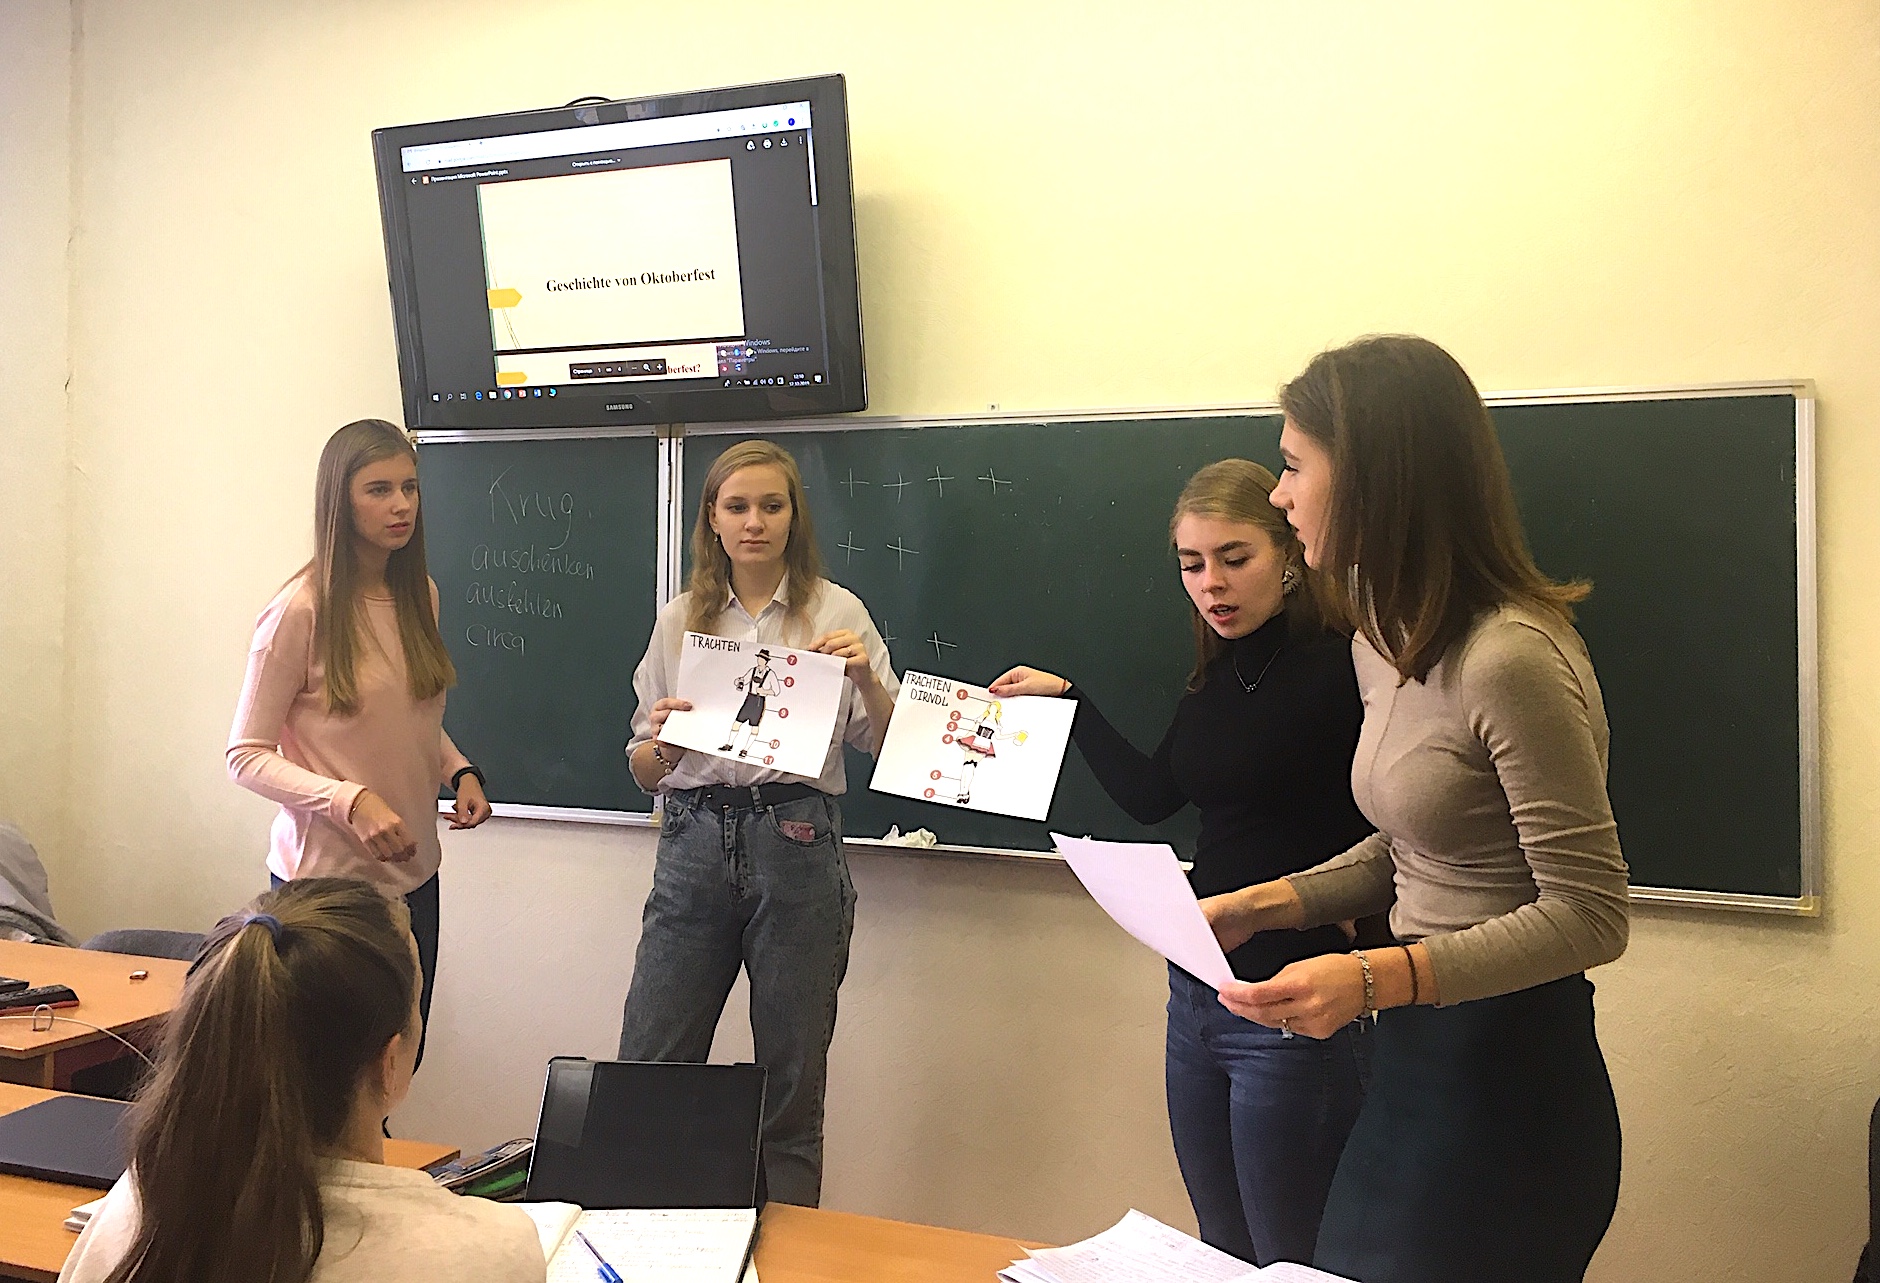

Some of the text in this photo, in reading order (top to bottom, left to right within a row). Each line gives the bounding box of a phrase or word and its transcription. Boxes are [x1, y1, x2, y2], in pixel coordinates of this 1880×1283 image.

[546, 268, 716, 293] Geschichte von Oktoberfest
[667, 363, 701, 375] berfest?
[605, 403, 633, 411] SAMSUNG
[690, 634, 741, 653] TRACHTEN
[905, 672, 952, 693] TRACHTEN
[910, 688, 949, 707] DIRNDL
